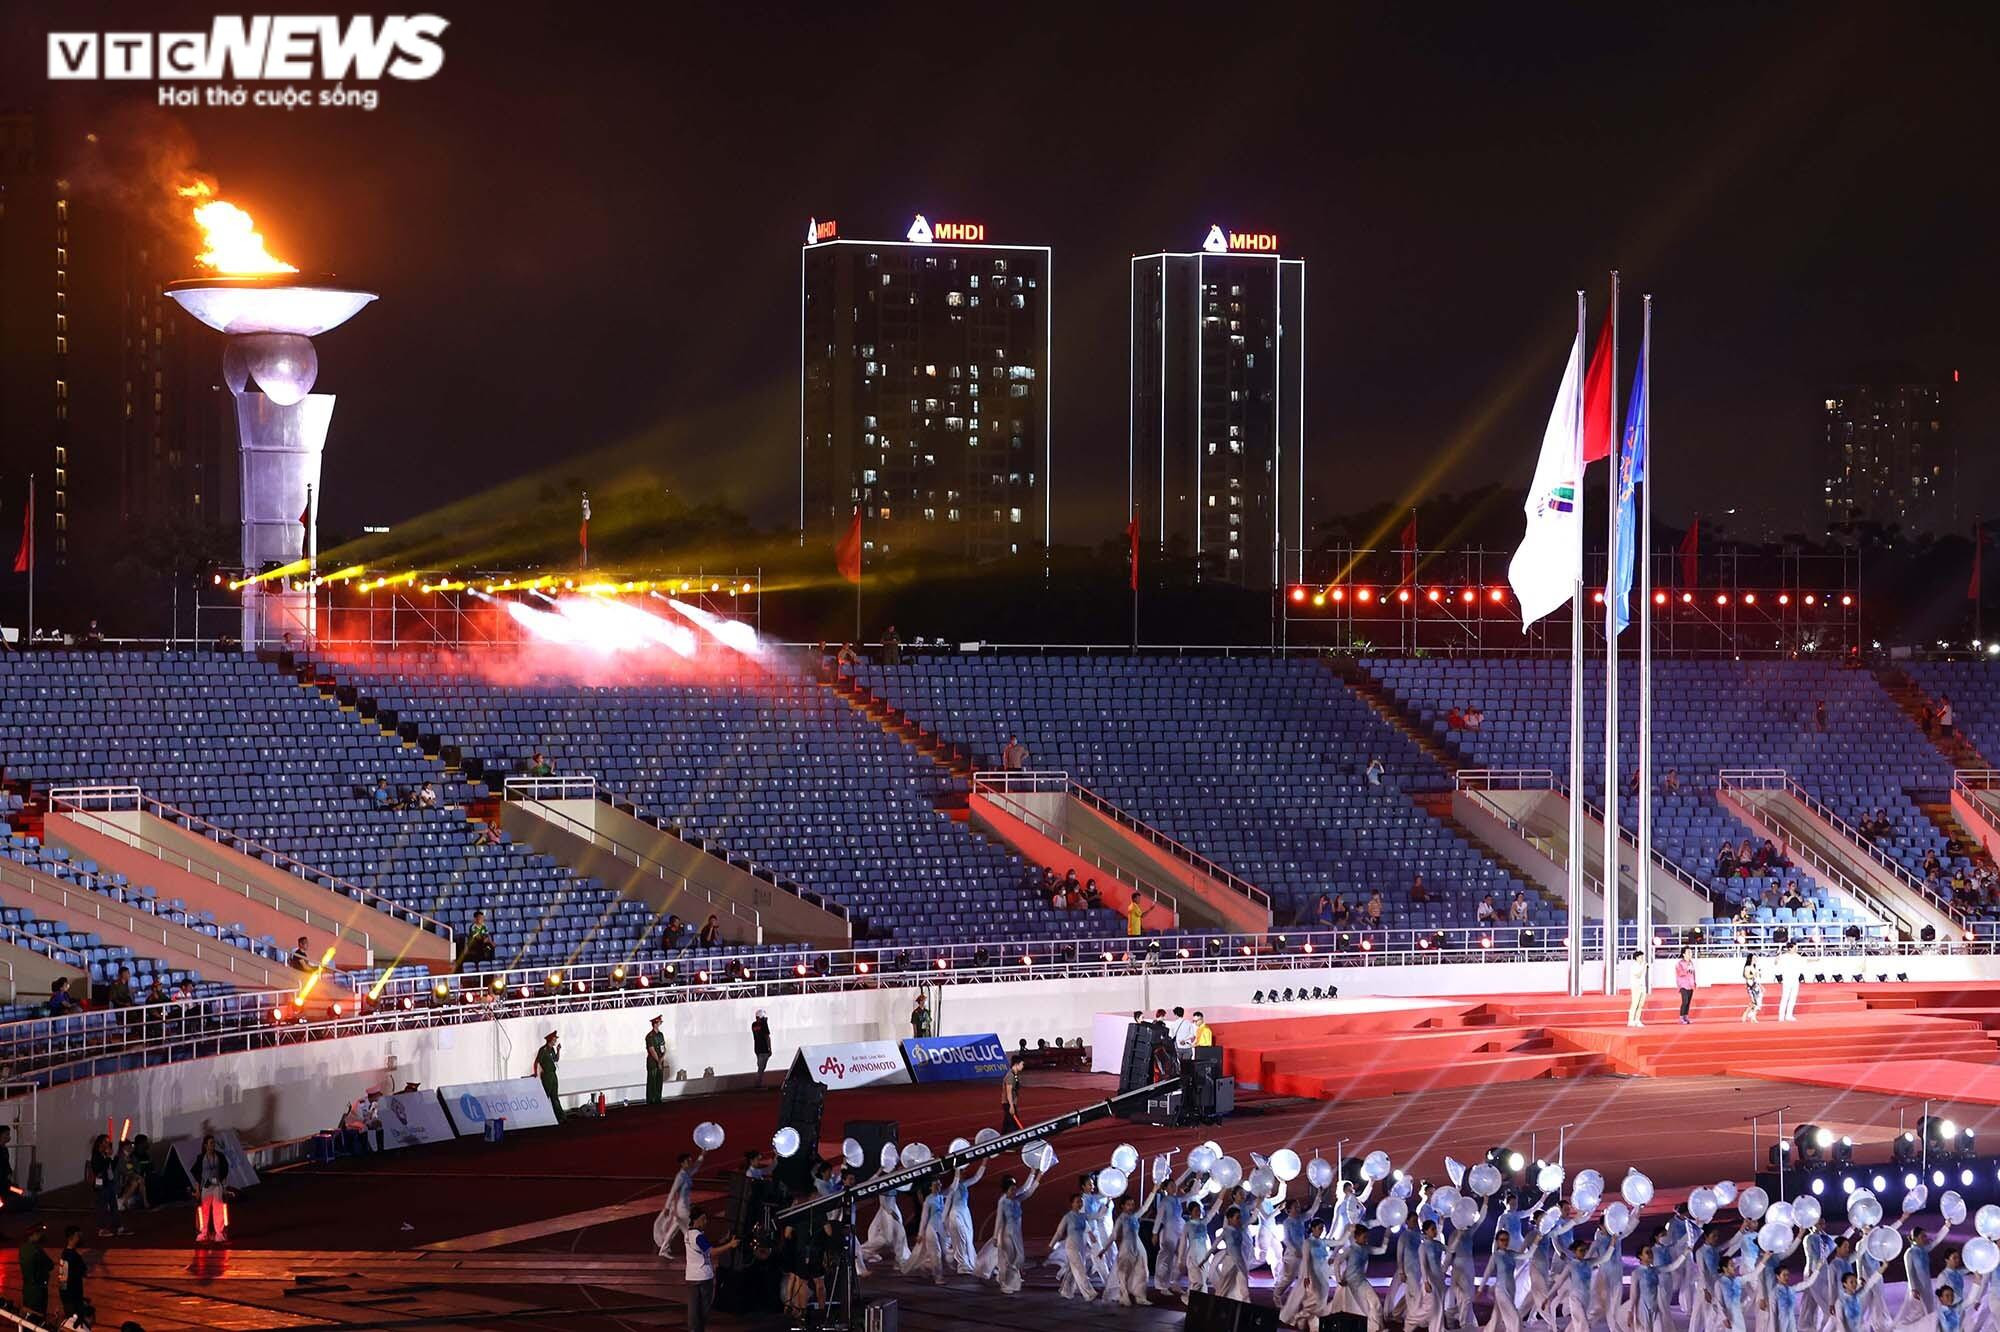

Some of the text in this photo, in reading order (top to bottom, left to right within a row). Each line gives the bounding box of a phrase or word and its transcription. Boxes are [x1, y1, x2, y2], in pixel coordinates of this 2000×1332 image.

[817, 221, 836, 239] MHDI
[934, 223, 985, 241] MHDI
[1229, 233, 1278, 250] MHDI
[928, 1044, 1003, 1064] DONGLUC
[849, 1061, 896, 1073] AJINOMOTO
[856, 1166, 933, 1197] SCANNER
